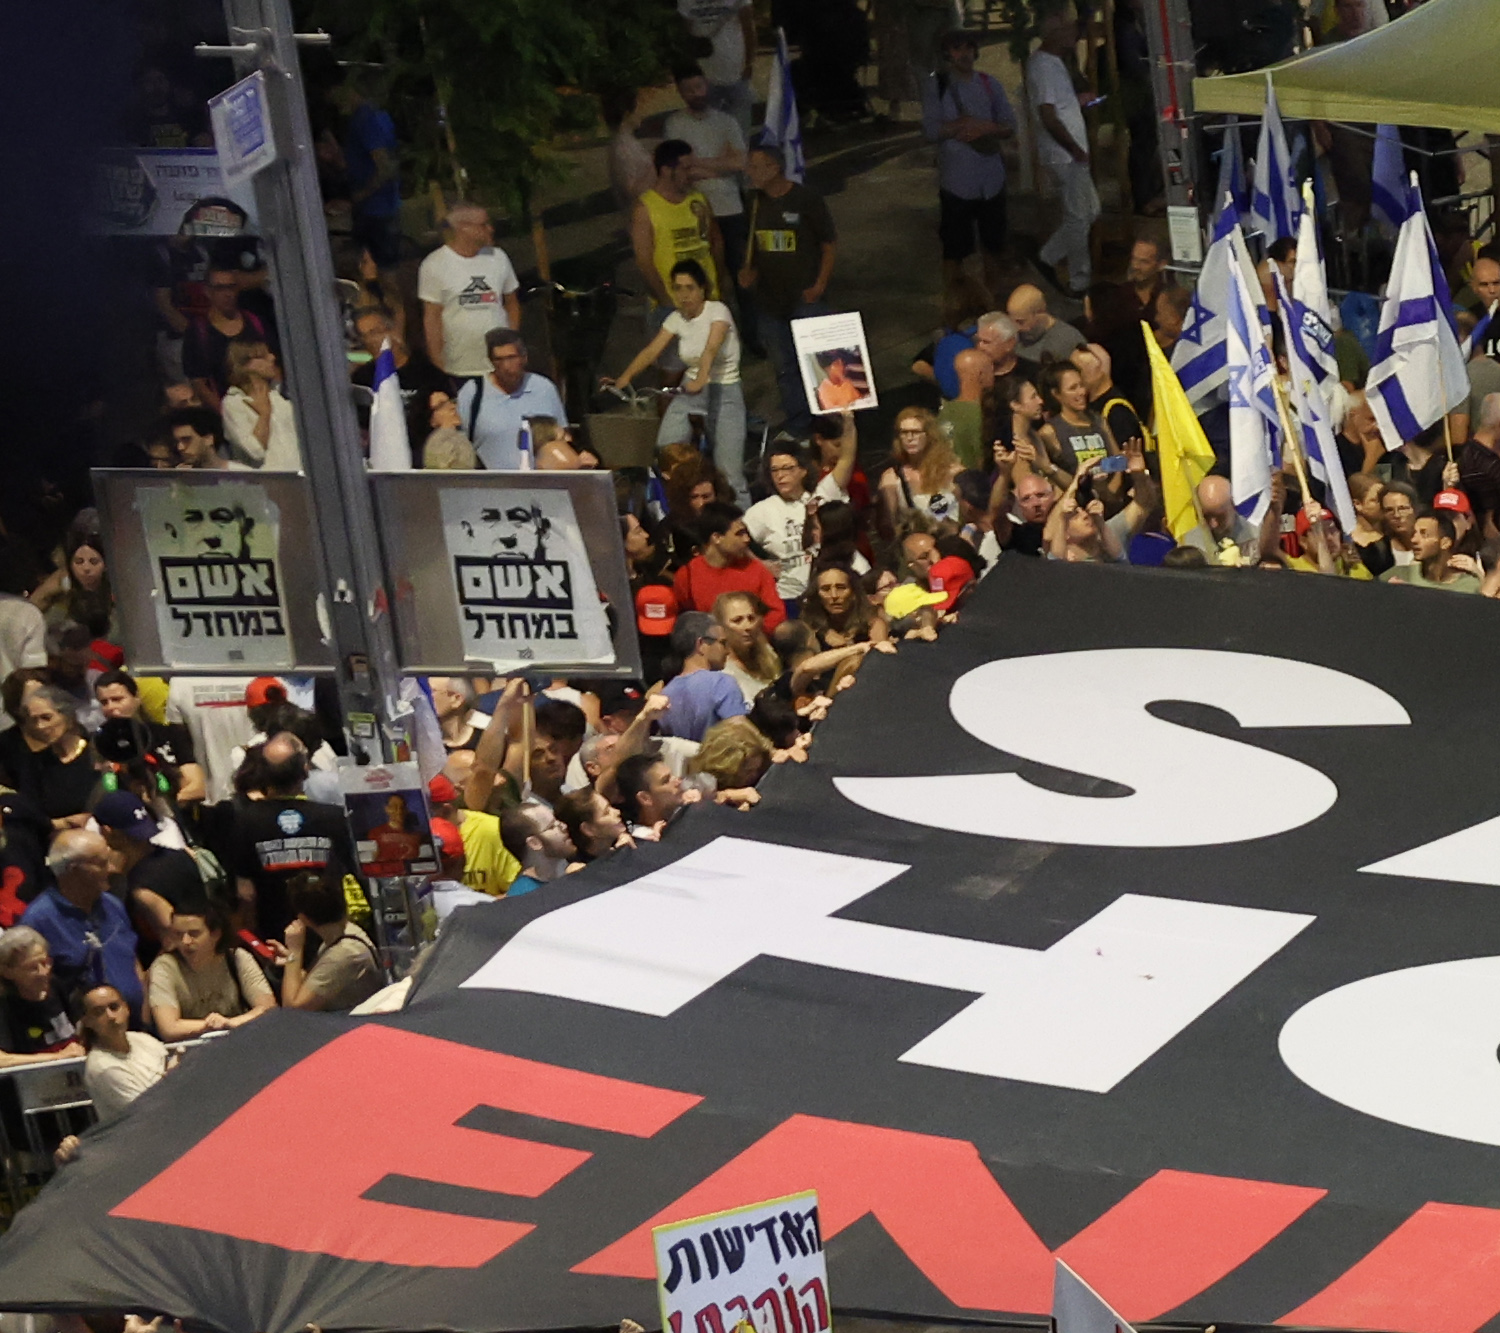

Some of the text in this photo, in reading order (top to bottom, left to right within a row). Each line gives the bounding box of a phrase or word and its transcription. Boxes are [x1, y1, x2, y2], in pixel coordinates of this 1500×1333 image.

[165, 561, 275, 599] אשם
[460, 561, 571, 603] אשם
[171, 604, 285, 638] במחדל
[463, 609, 579, 642] במחדל
[663, 1207, 823, 1294] האדישות
